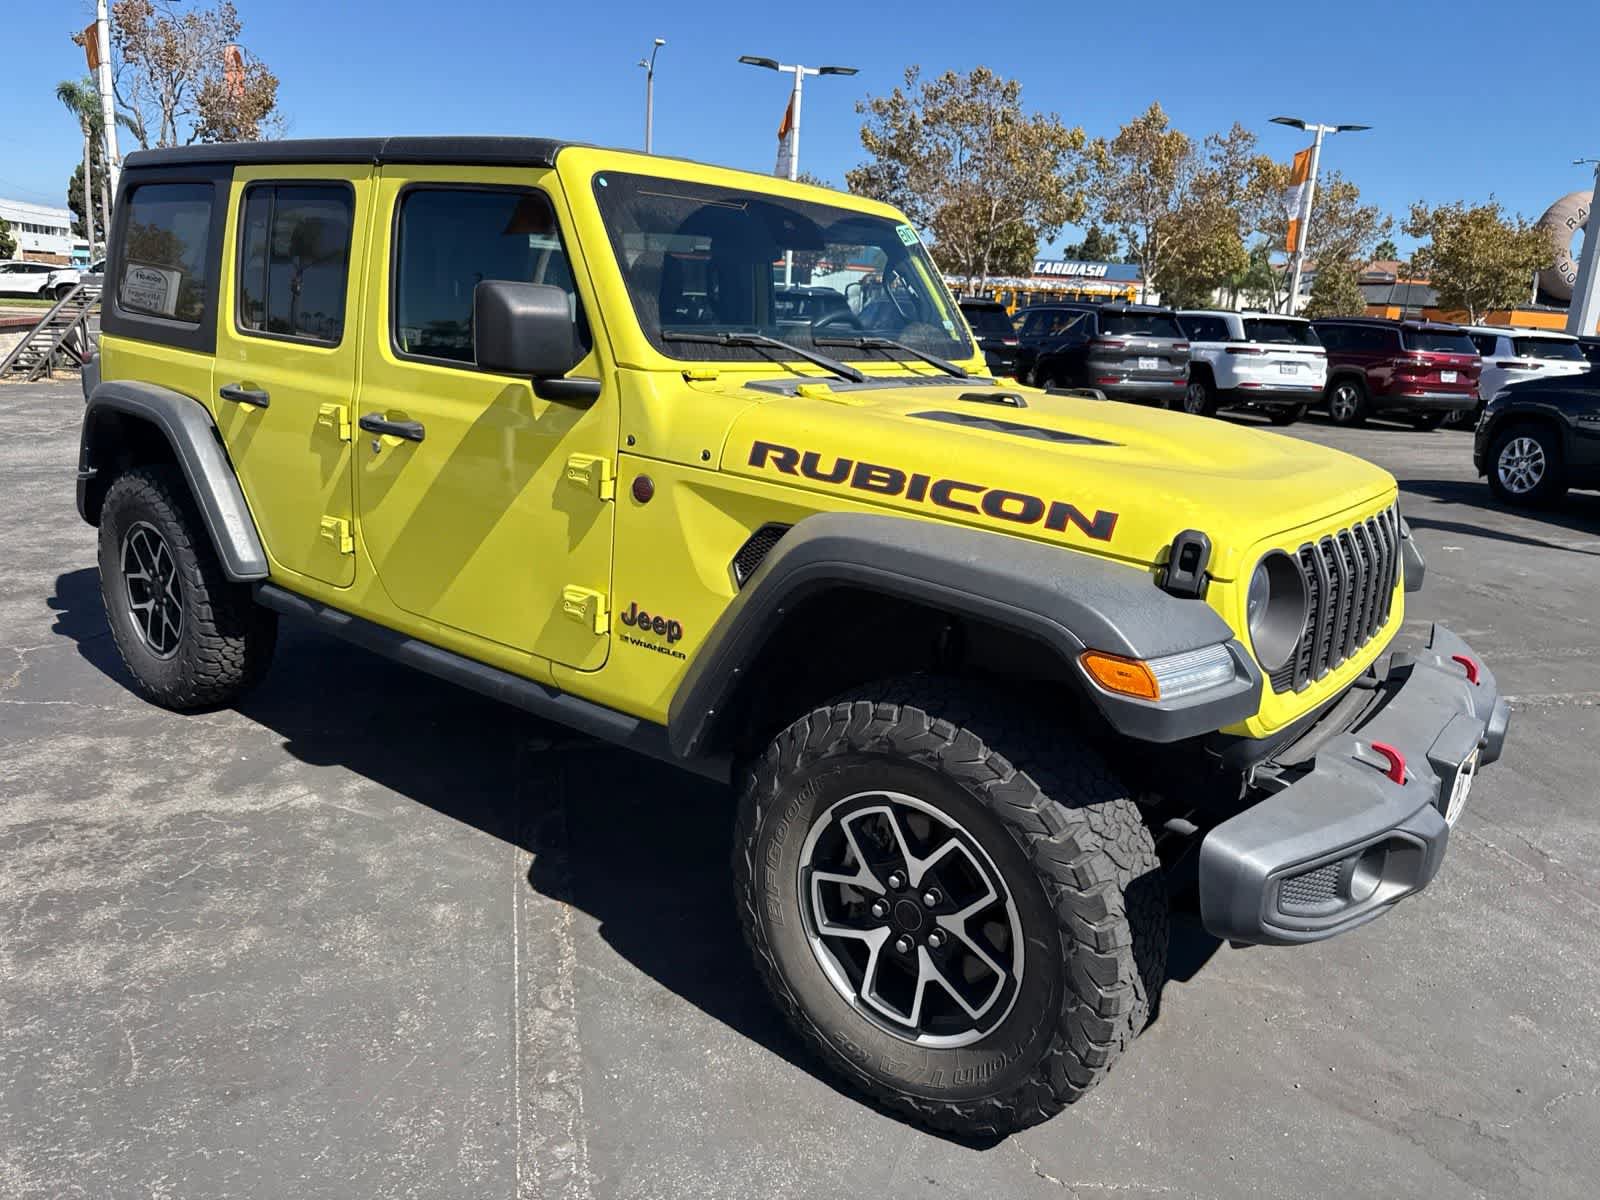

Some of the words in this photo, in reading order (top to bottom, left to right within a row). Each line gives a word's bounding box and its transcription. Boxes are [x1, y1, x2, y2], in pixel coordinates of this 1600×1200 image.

[1565, 202, 1591, 230] RA
[1034, 260, 1108, 278] CARWASH
[748, 441, 1118, 542] RUBICON
[621, 602, 682, 644] Jeep
[630, 638, 686, 660] WRANGLER
